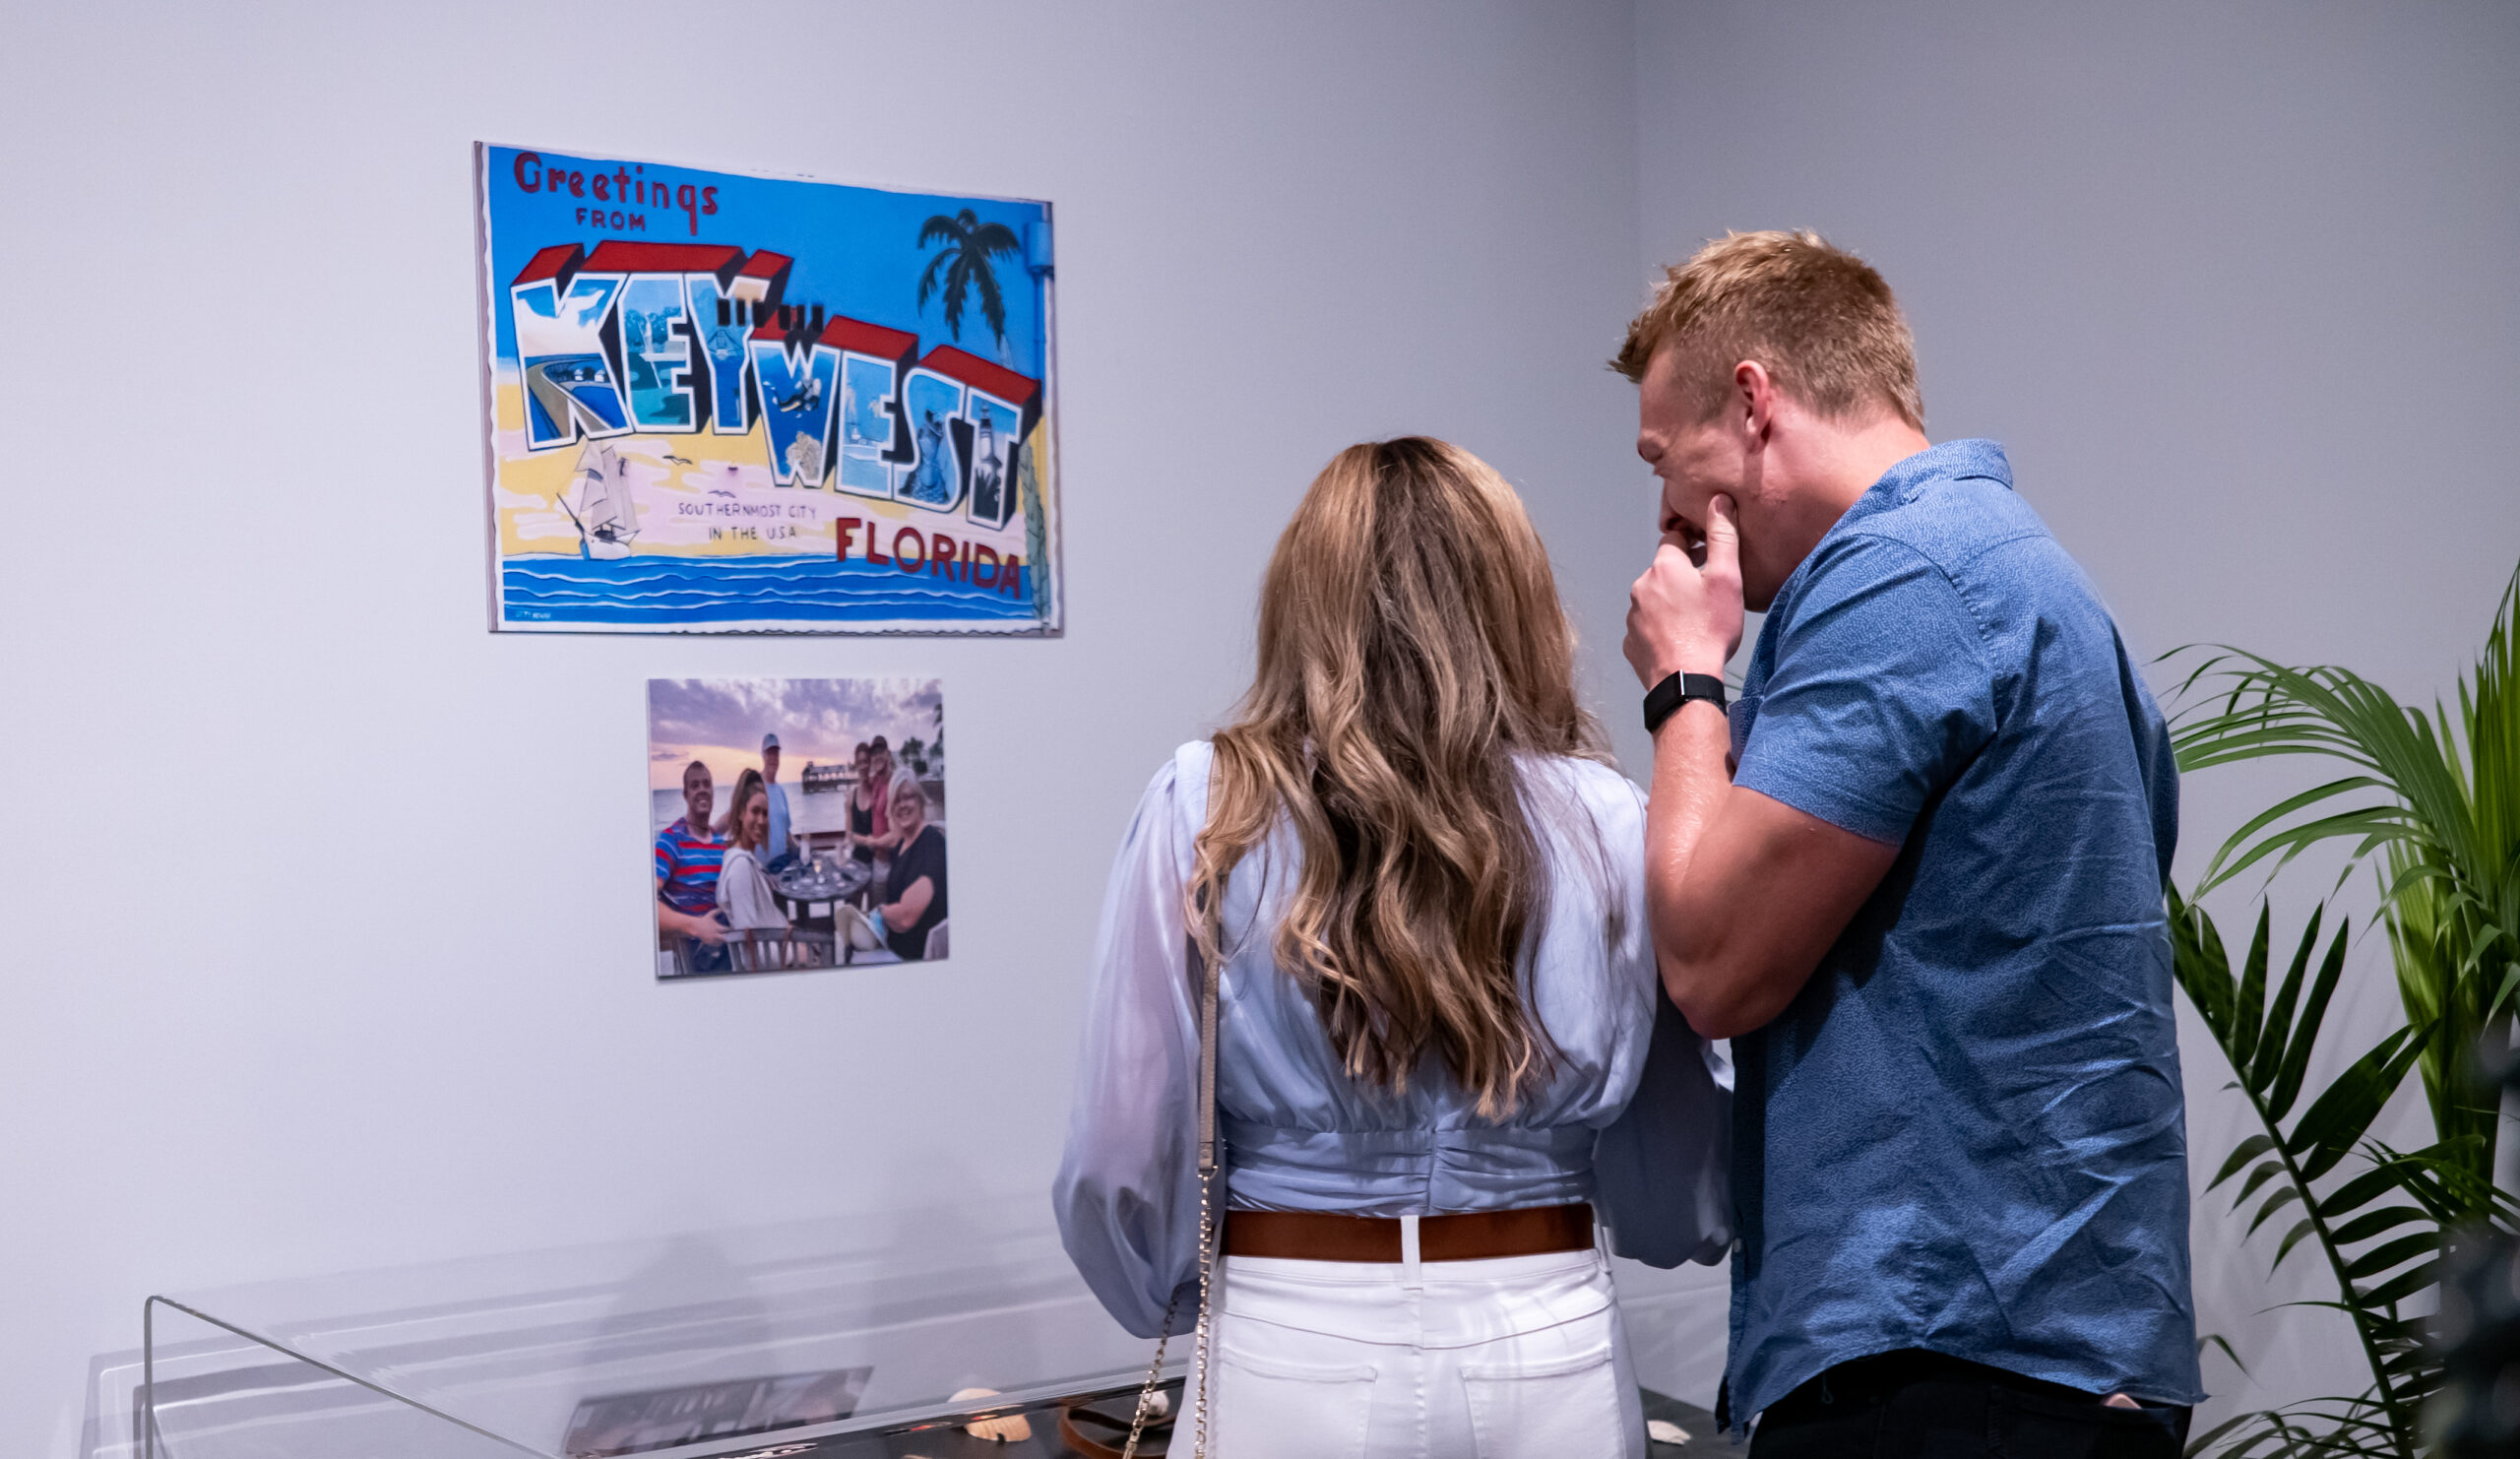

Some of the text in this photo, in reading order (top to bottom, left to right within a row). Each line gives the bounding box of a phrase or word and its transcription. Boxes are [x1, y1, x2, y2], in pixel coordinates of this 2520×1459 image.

[514, 152, 719, 236] Greetings
[575, 208, 646, 232] FROM
[510, 258, 1034, 532] KEY WEST
[678, 502, 817, 520] SOUTHERNMOST CITY
[709, 527, 723, 540] IN
[731, 526, 757, 540] THE
[836, 517, 1021, 601] FLORIDA
